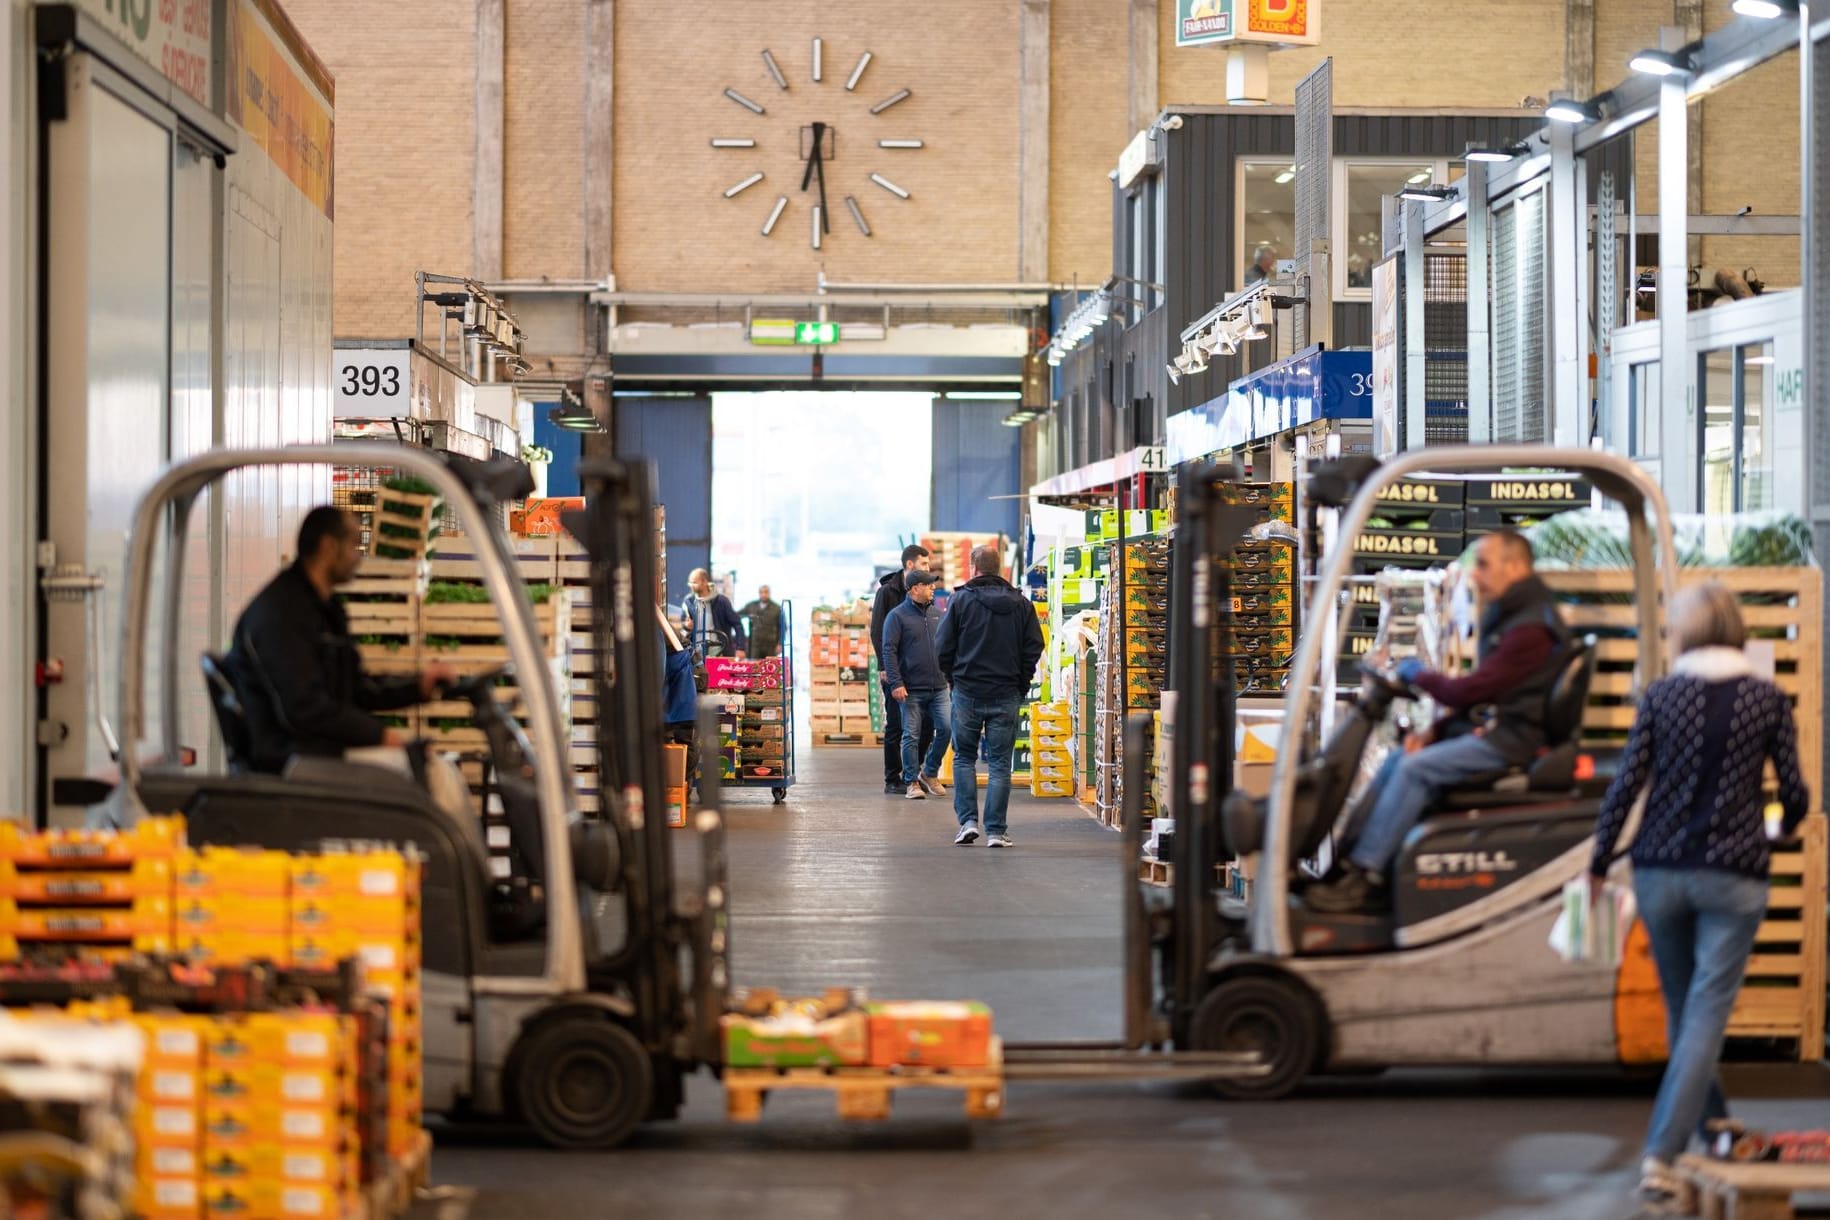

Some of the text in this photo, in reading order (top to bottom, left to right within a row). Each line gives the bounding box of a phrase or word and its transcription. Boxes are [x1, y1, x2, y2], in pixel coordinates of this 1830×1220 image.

[341, 365, 400, 396] 393
[1141, 448, 1166, 469] 41
[1376, 484, 1439, 503] DASOL
[1491, 482, 1575, 500] INDASOL
[1354, 535, 1439, 555] INDASOL
[1233, 600, 1240, 609] 8
[1416, 851, 1516, 873] STILL
